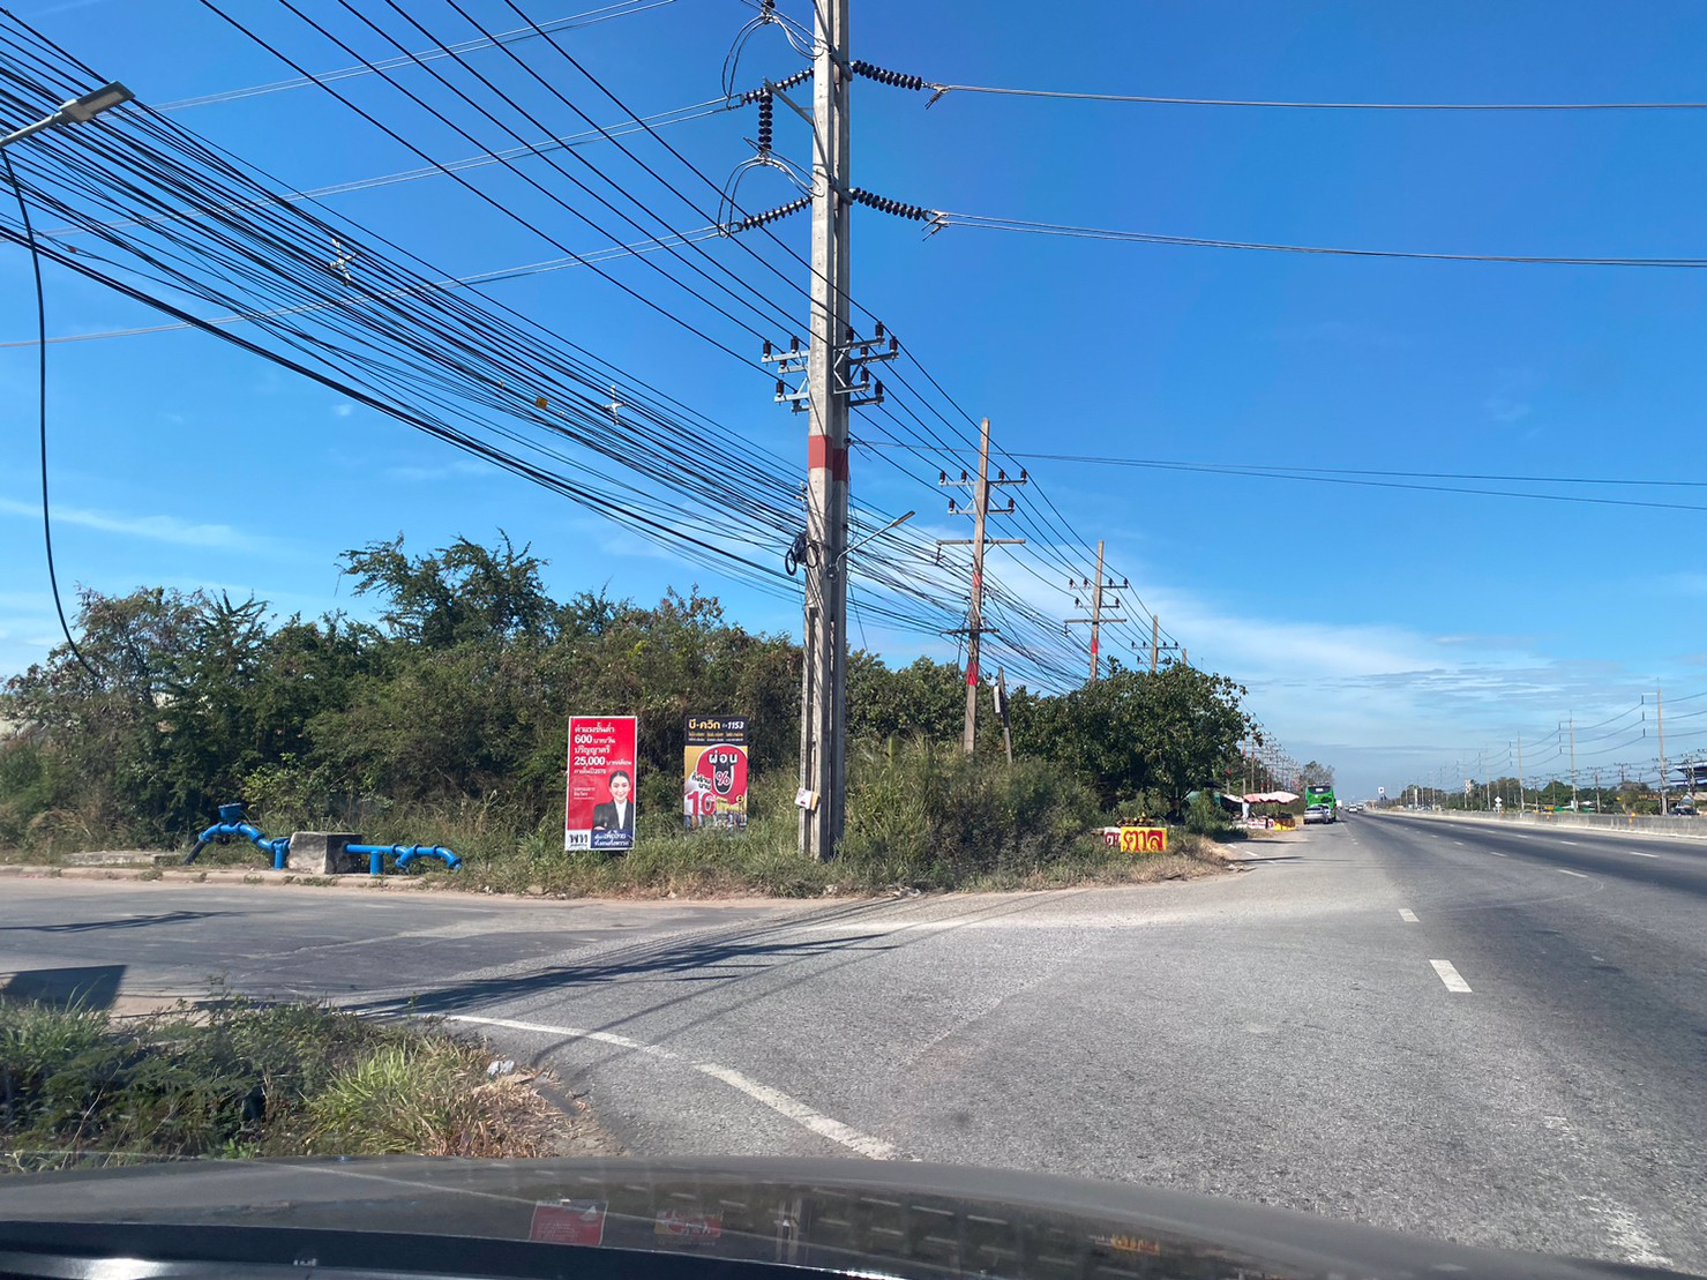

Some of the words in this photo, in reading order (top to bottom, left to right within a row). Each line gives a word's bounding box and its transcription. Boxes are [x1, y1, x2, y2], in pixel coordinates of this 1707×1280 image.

[574, 734, 593, 744] 600
[574, 745, 610, 755] ปริญญาตรี
[574, 756, 605, 766] 25,000
[708, 750, 738, 764] ผ่อน
[687, 791, 716, 817] 10
[1123, 830, 1163, 853] ตาล
